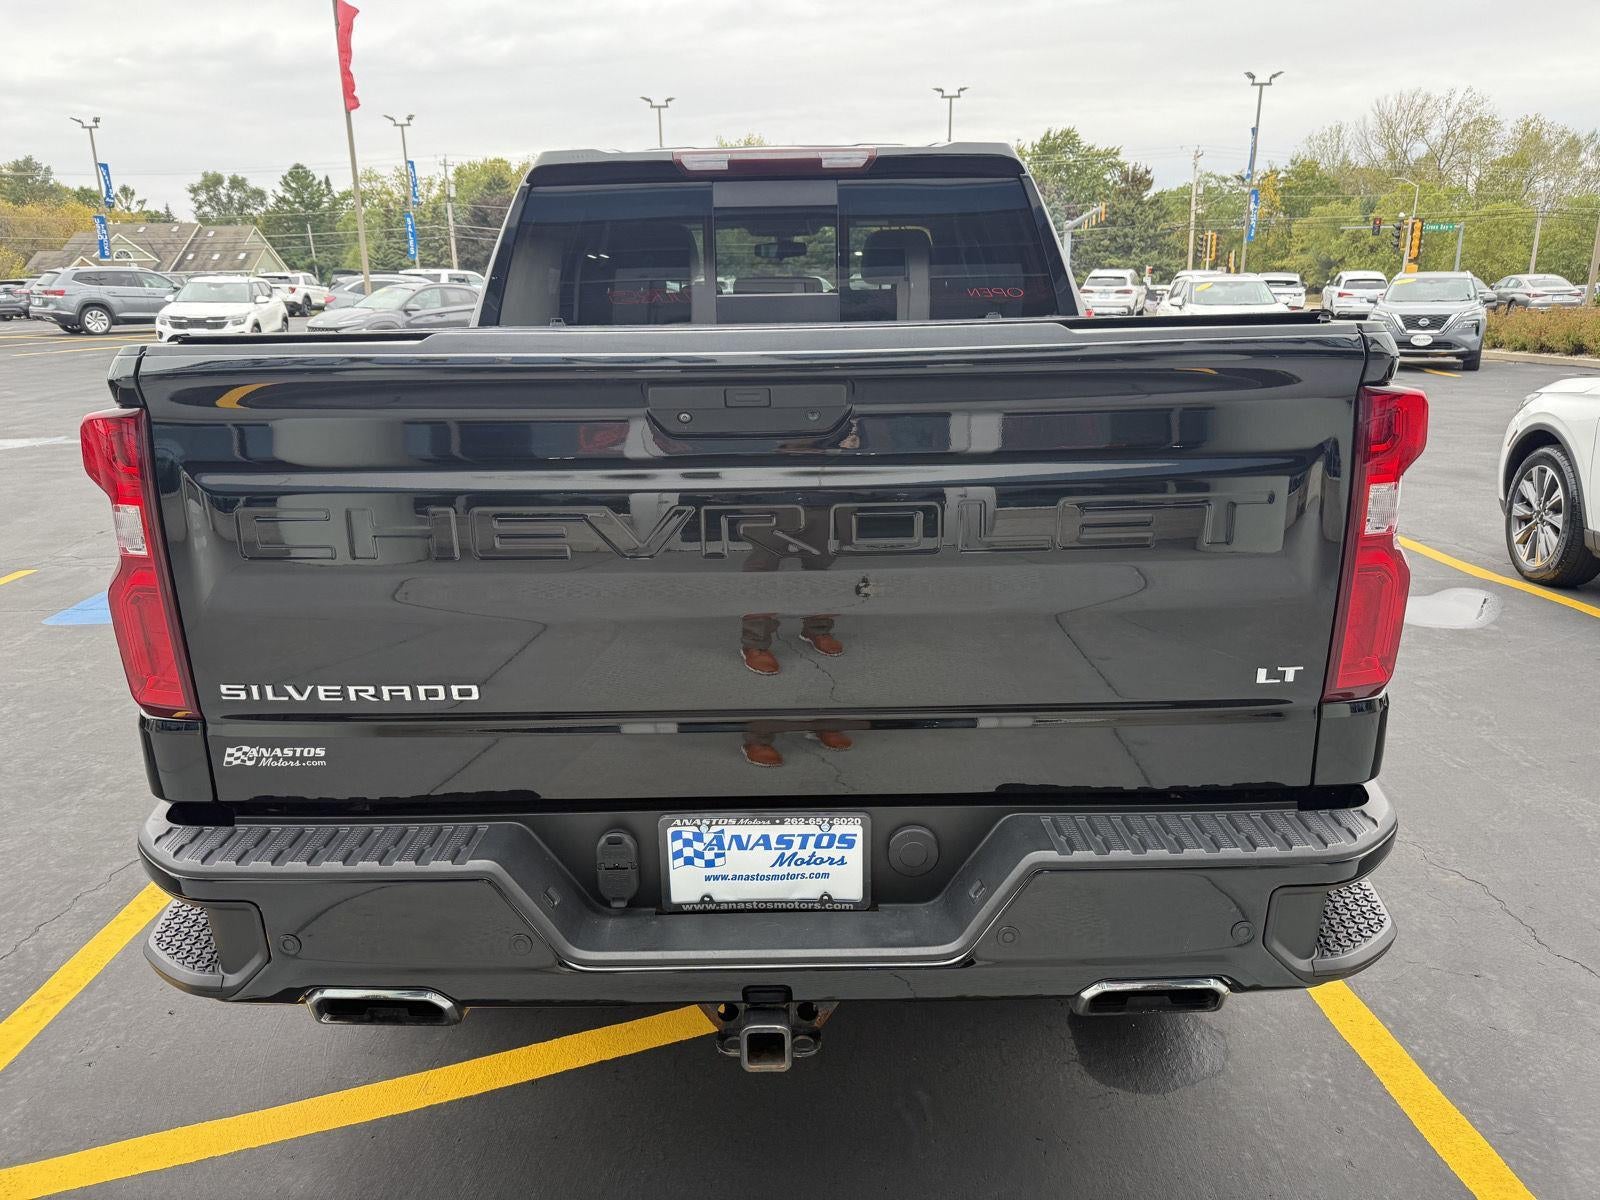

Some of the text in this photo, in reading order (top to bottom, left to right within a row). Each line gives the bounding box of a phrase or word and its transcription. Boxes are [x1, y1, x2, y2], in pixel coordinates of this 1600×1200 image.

[1440, 223, 1449, 231] Bay
[100, 223, 110, 256] TRUCKS
[406, 217, 415, 255] SALES
[234, 490, 1277, 561] CHEVROLET
[1256, 666, 1304, 684] LT
[219, 684, 480, 702] SILVERADO
[246, 746, 327, 758] ANASTOS
[671, 818, 738, 826] ANASTOS
[783, 817, 862, 826] 262-657-6020
[702, 829, 858, 852] ANASTOS
[769, 851, 848, 868] Motors
[704, 871, 830, 882] www.anastosmotors.com
[681, 901, 854, 912] www.anastosmotors.com
